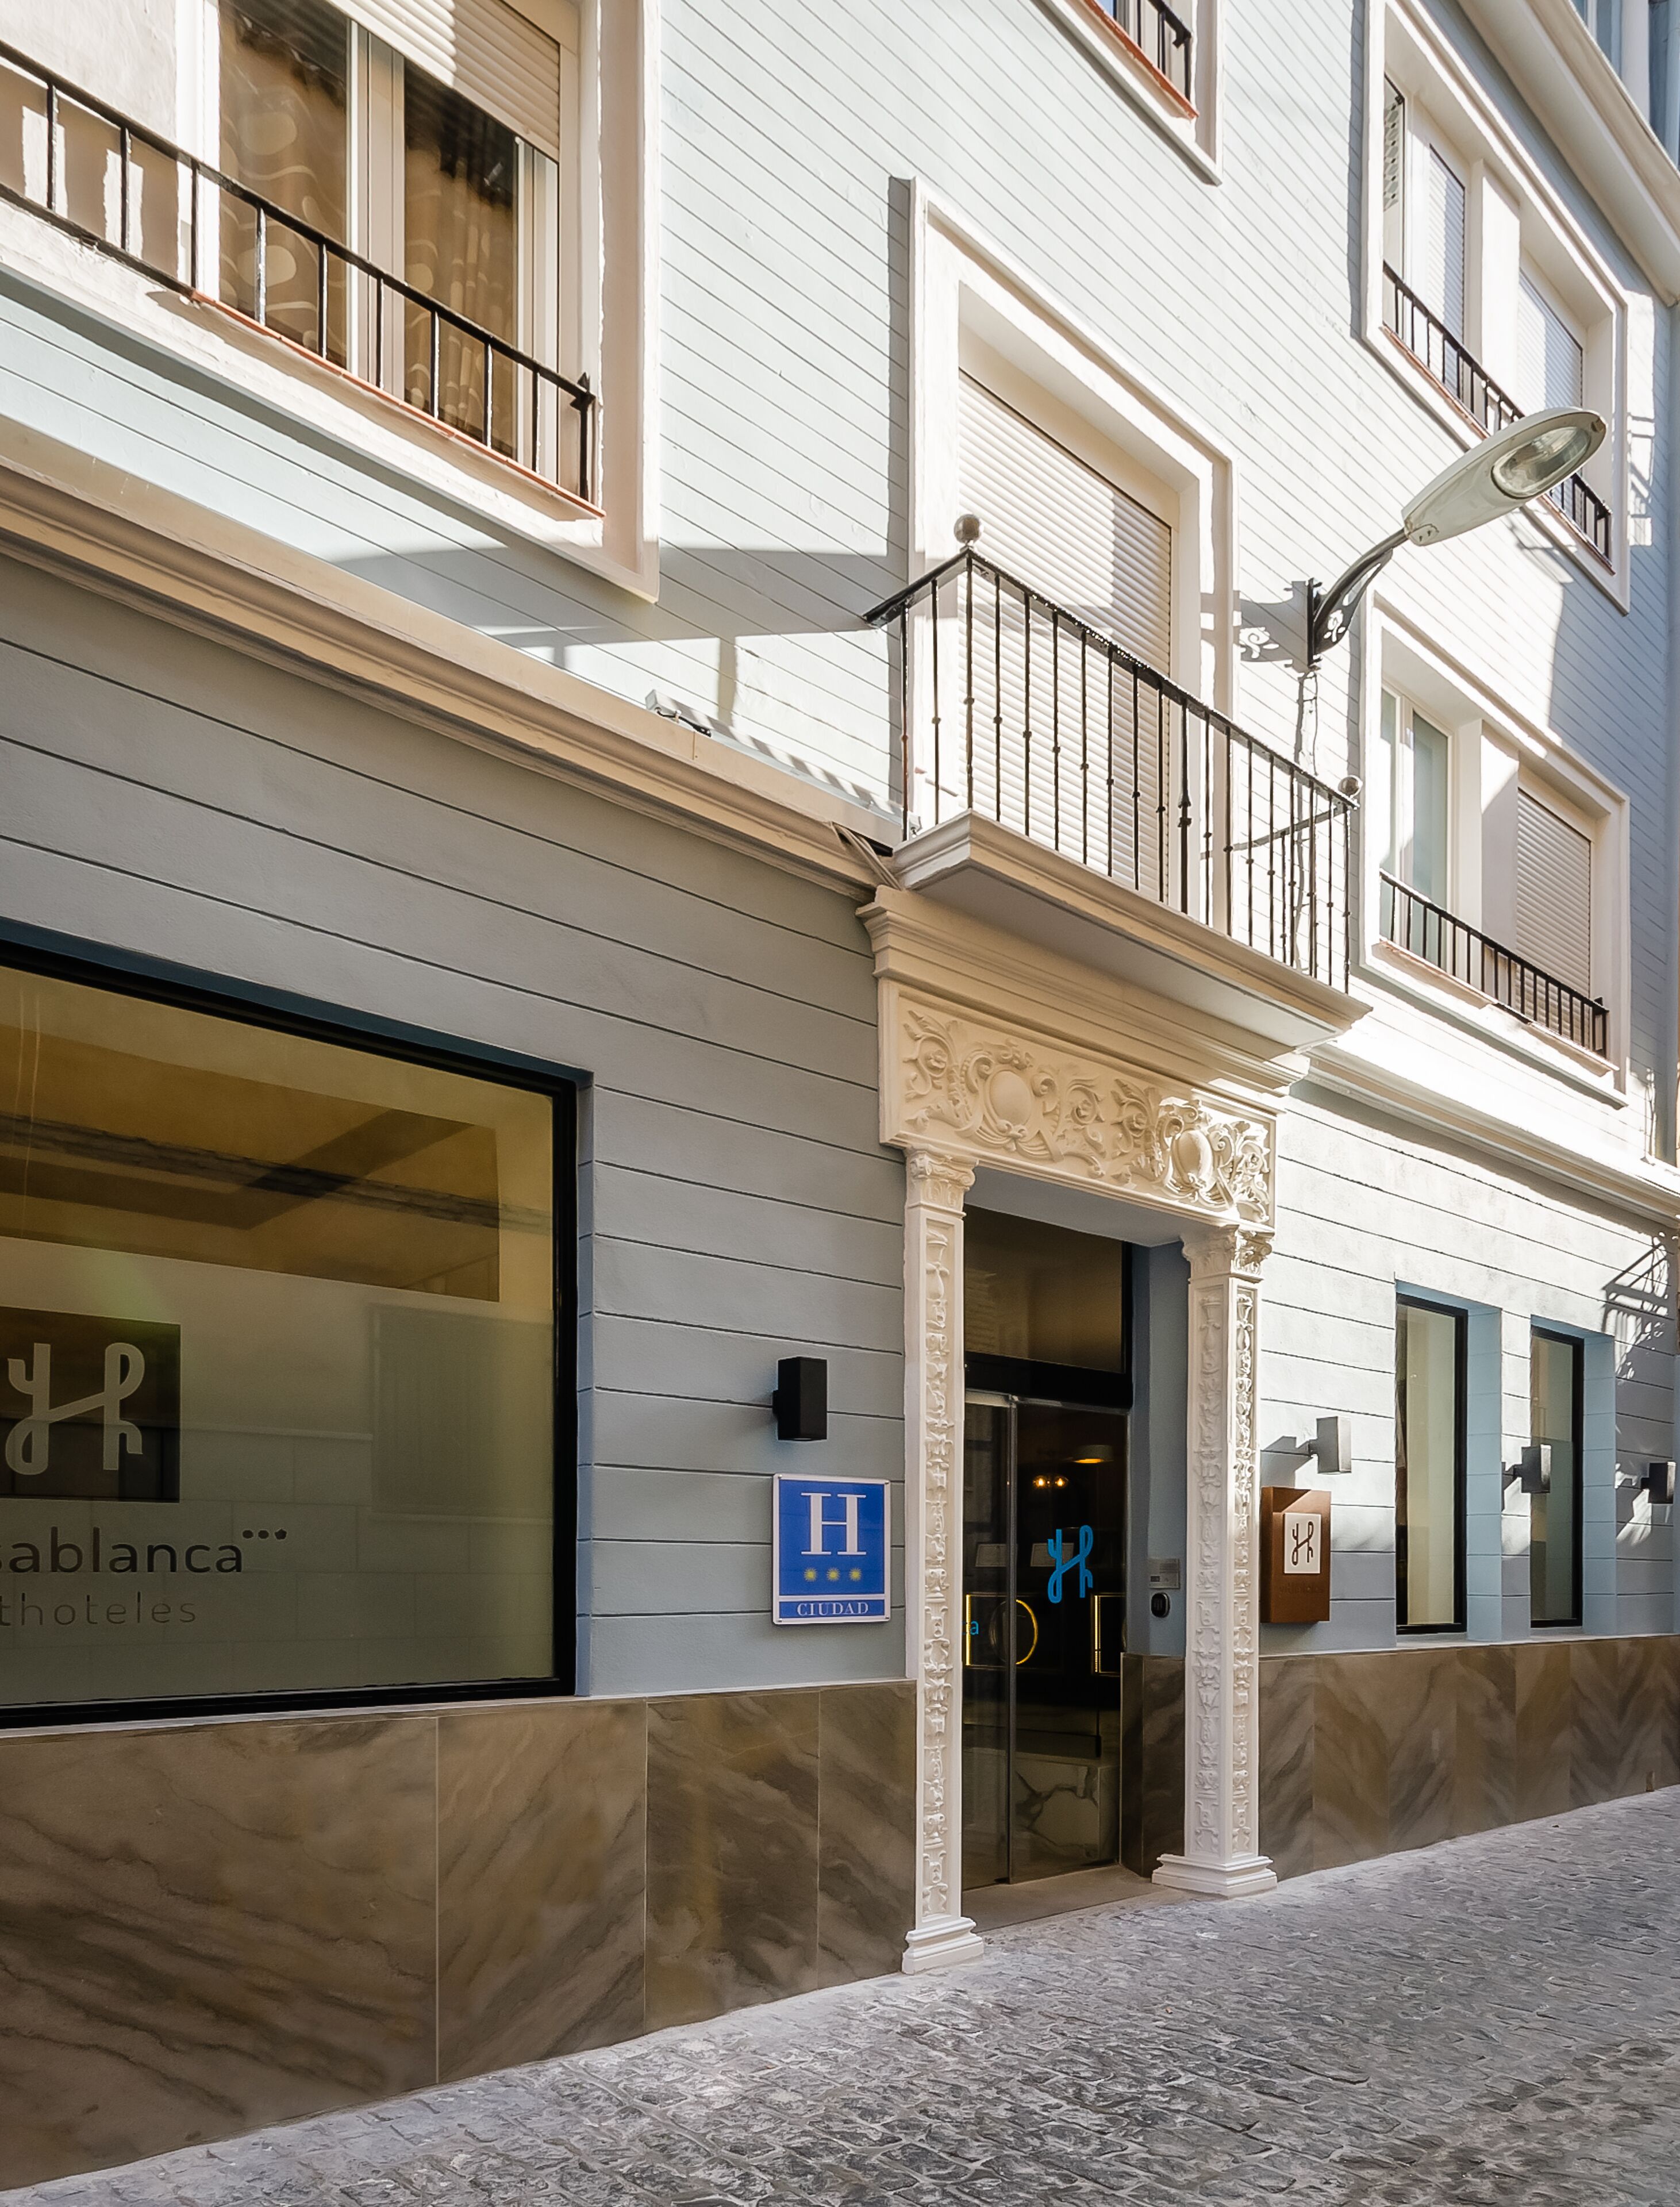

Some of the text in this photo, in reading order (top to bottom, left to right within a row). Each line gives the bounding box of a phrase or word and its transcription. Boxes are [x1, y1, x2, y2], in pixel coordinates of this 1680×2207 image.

[801, 1492, 867, 1555] H
[0, 1526, 243, 1573] ablanca
[797, 1602, 869, 1616] CIUDAD
